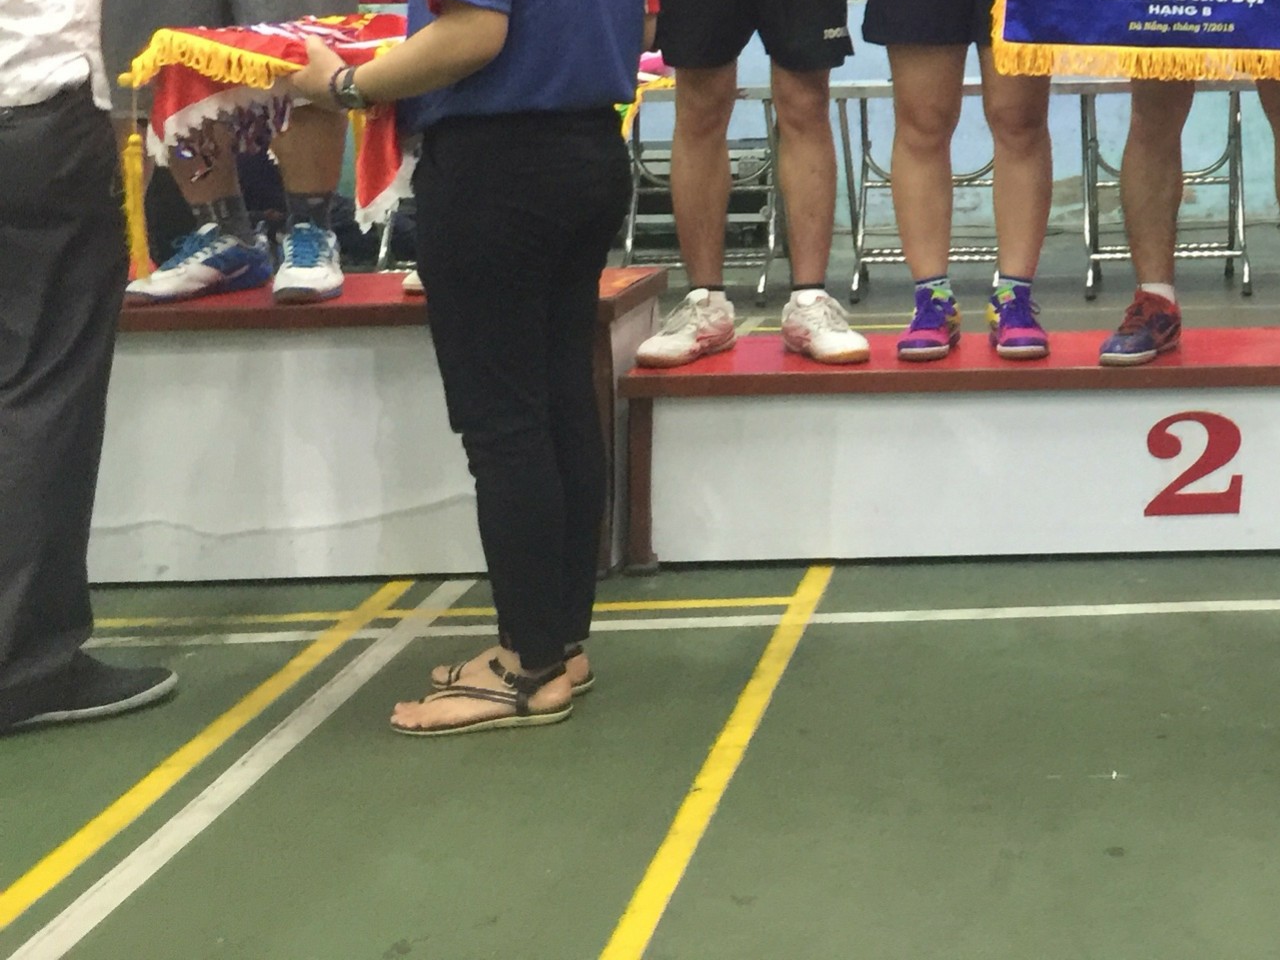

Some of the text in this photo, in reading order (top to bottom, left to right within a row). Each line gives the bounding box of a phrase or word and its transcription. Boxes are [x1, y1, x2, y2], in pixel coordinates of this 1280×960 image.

[1148, 4, 1213, 17] HẠNG B
[1144, 411, 1243, 517] 2
